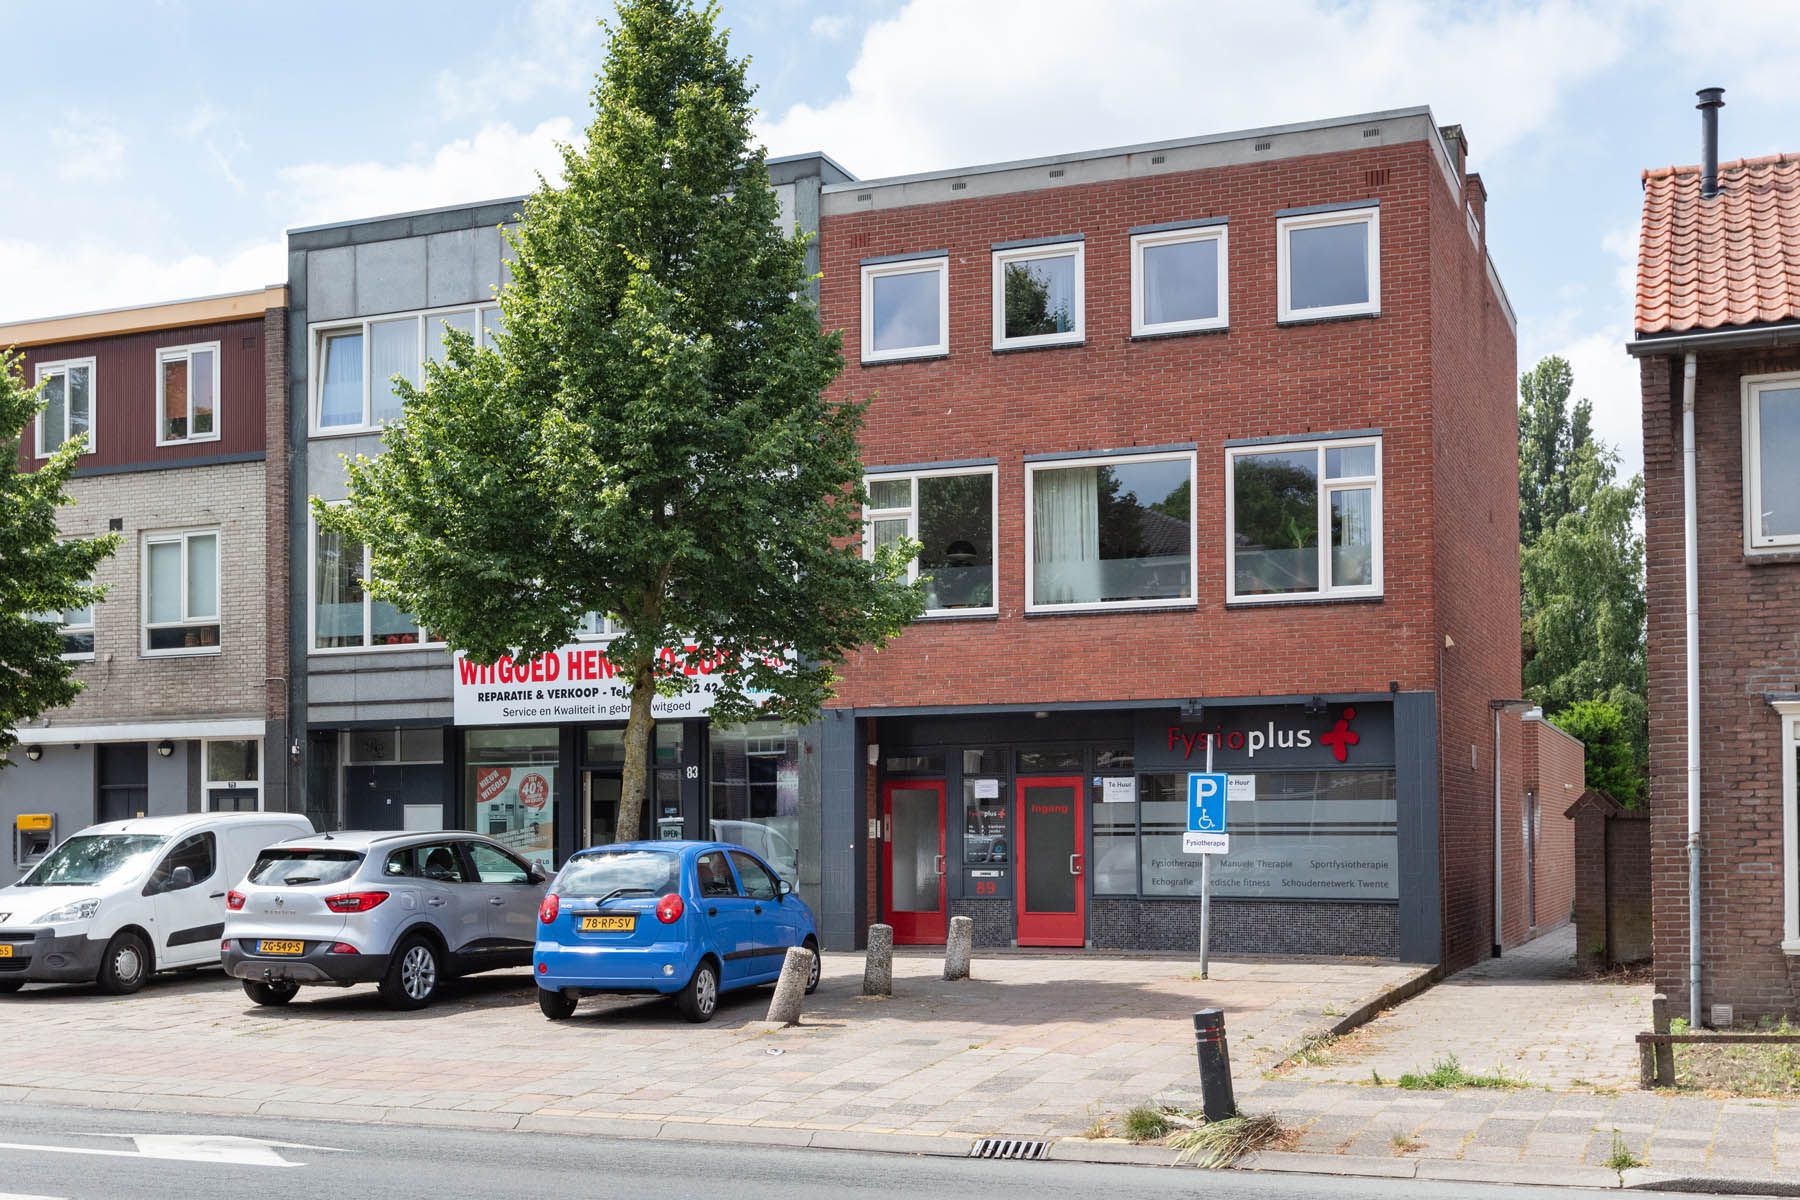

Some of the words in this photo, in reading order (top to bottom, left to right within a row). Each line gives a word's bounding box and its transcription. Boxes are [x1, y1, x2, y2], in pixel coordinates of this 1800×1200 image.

[477, 691, 533, 702] REPARATIE
[536, 690, 544, 700] &
[547, 687, 599, 699] VERKOOP
[502, 706, 537, 717] Service
[539, 706, 551, 715] en
[554, 702, 596, 715] Kwaliteit
[597, 701, 607, 713] in
[652, 701, 691, 713] witgoed
[479, 769, 500, 789] NIEUW
[687, 766, 699, 779] 83
[480, 775, 508, 800] WITGOED
[521, 780, 544, 795] 40%
[1196, 778, 1218, 808] P
[1032, 803, 1069, 816] Ingang
[663, 829, 679, 839] OPEN
[1186, 839, 1226, 848] Fysiotherapie
[1257, 860, 1294, 870] Therapie
[1310, 859, 1390, 871] Sportfysiotherapie
[976, 881, 996, 895] 89
[1151, 877, 1194, 888] Echografie
[1210, 878, 1241, 888] edische
[1243, 878, 1271, 888] fitness
[1281, 878, 1355, 889] Schoudernetwerk
[1358, 879, 1390, 889] Twente
[585, 918, 632, 929] 78-RP-SV
[263, 941, 301, 952] ZG-549-S
